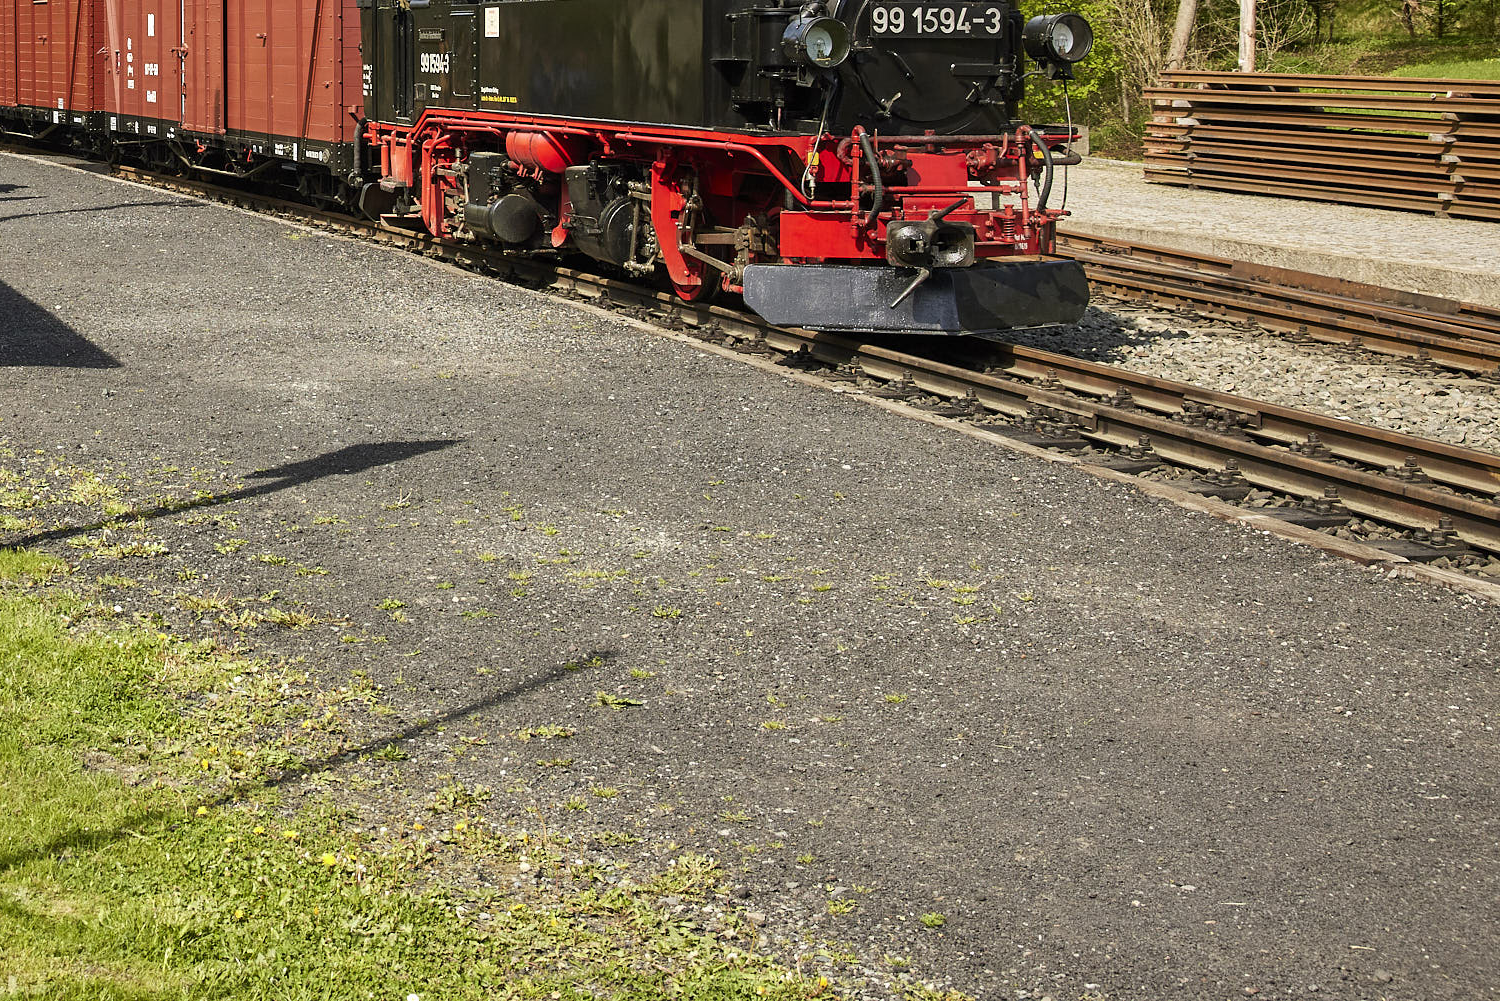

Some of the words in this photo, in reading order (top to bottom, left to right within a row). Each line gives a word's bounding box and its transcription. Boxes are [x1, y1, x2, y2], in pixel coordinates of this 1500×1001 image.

[872, 6, 905, 34] 99
[911, 6, 1001, 34] 1594-3
[420, 52, 430, 73] 99
